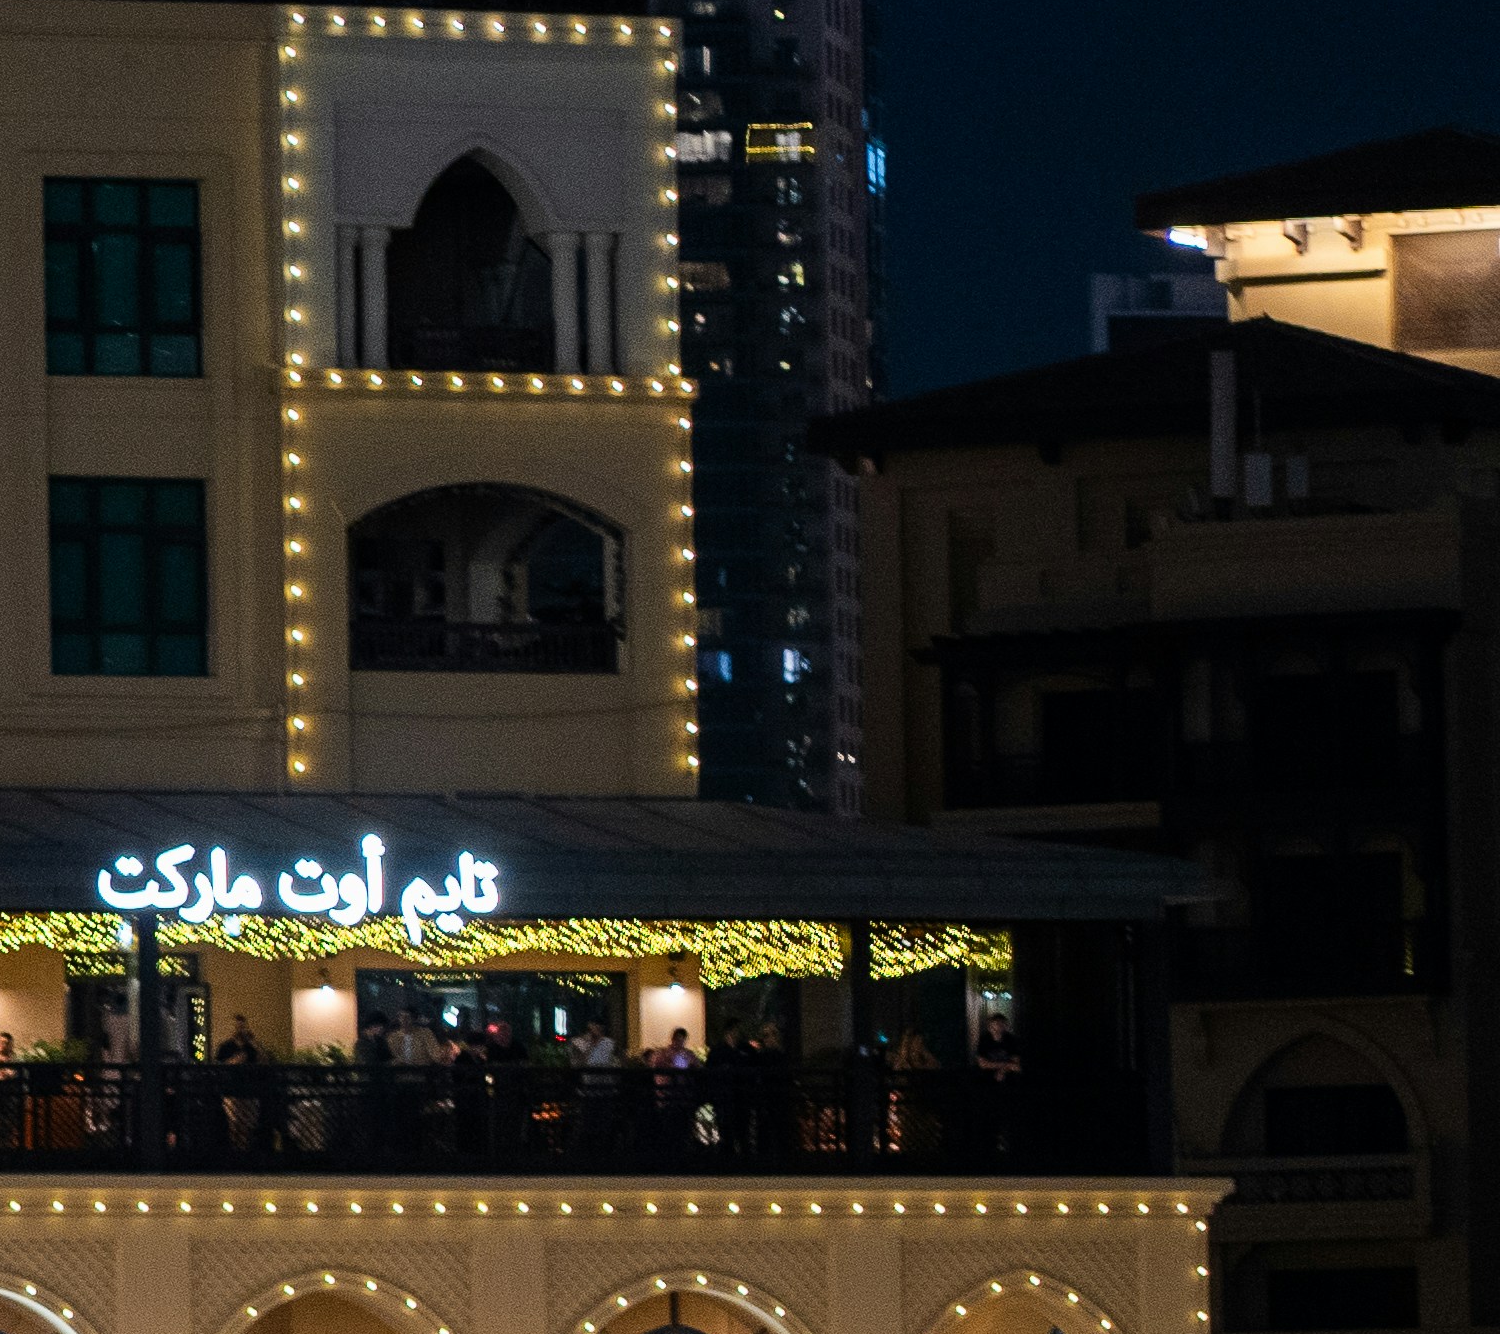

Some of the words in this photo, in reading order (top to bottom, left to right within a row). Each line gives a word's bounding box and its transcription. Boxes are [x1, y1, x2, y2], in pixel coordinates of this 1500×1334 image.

[97, 843, 264, 923] ماركت
[278, 833, 385, 926] أوت
[400, 850, 499, 945] تايم
